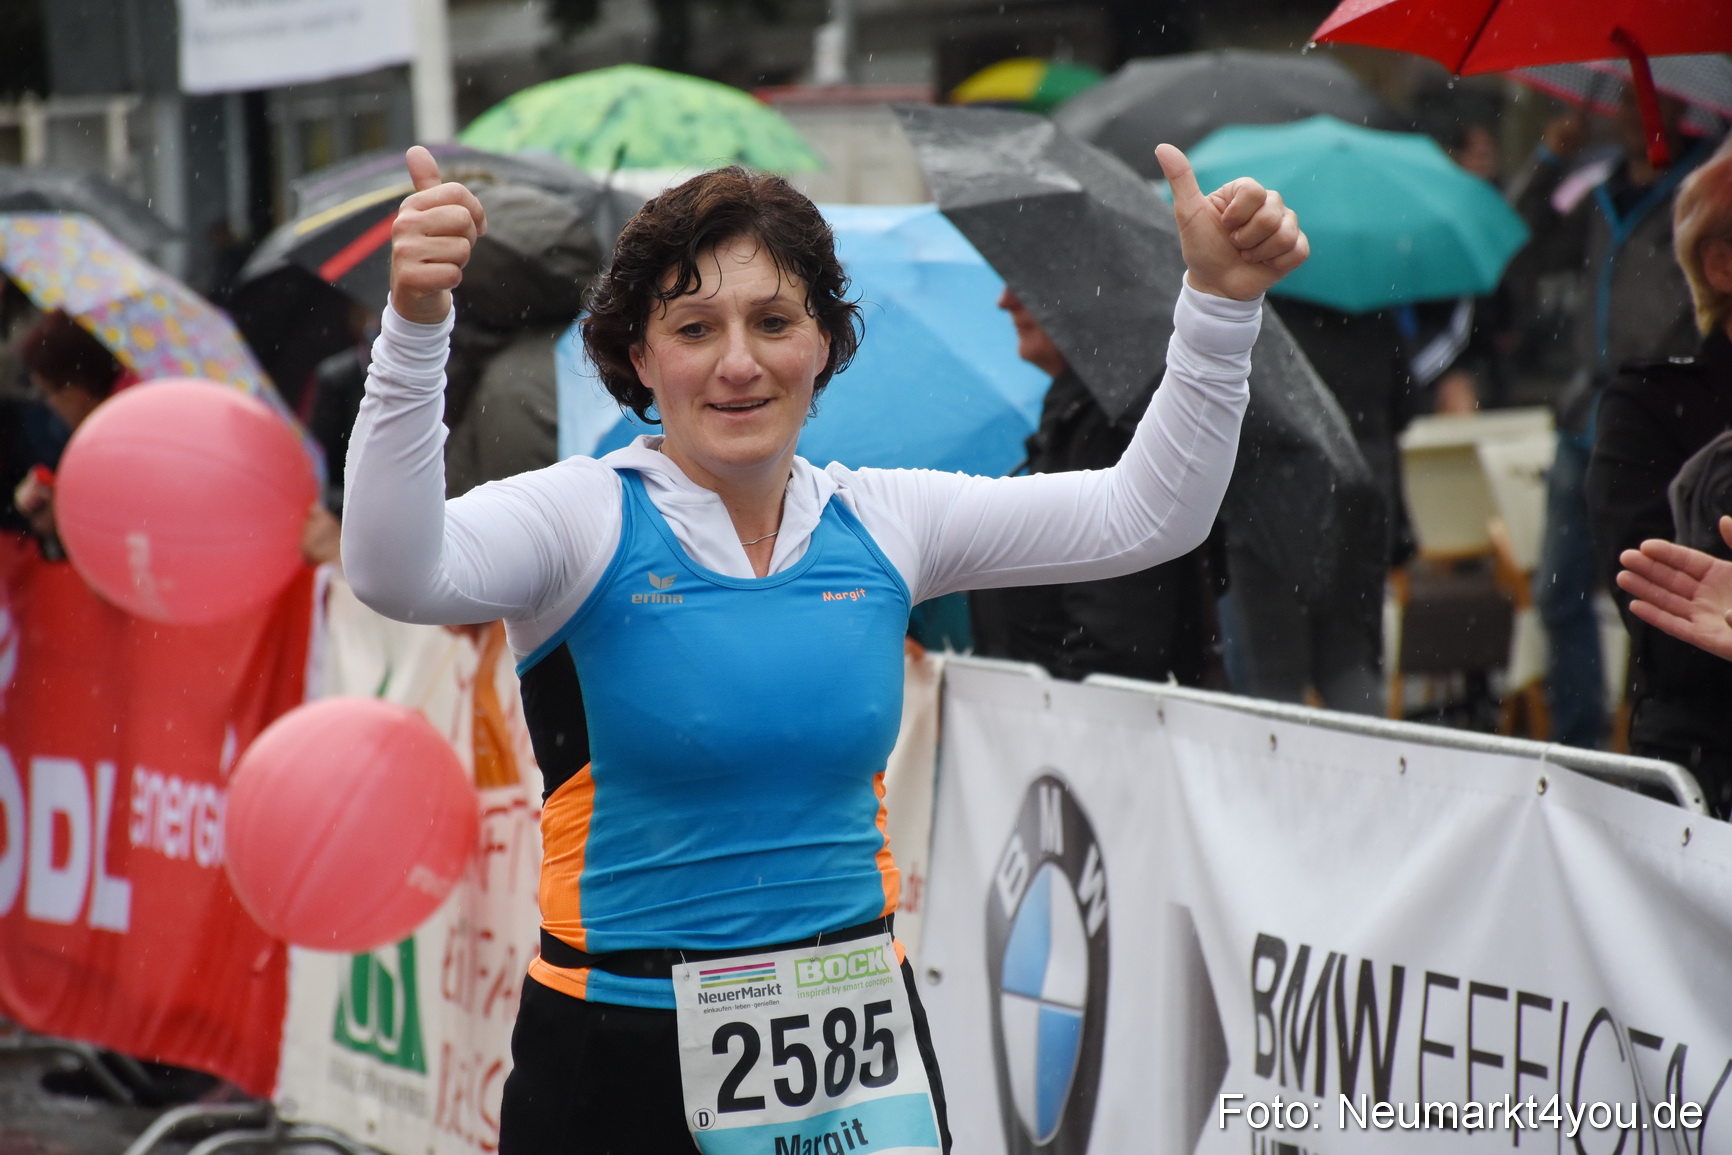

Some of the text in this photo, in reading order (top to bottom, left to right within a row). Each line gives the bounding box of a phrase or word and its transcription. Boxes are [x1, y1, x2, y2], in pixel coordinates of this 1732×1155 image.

[631, 593, 684, 604] erima
[821, 588, 867, 602] Margit
[996, 785, 1108, 938] BMW
[795, 947, 890, 987] BOCK
[698, 983, 782, 1005] NeuerMarkt
[797, 976, 893, 999] inspired by smart concepts
[1252, 931, 1406, 1110] BMW
[711, 999, 899, 1114] 2585
[774, 1118, 869, 1155] Margit
